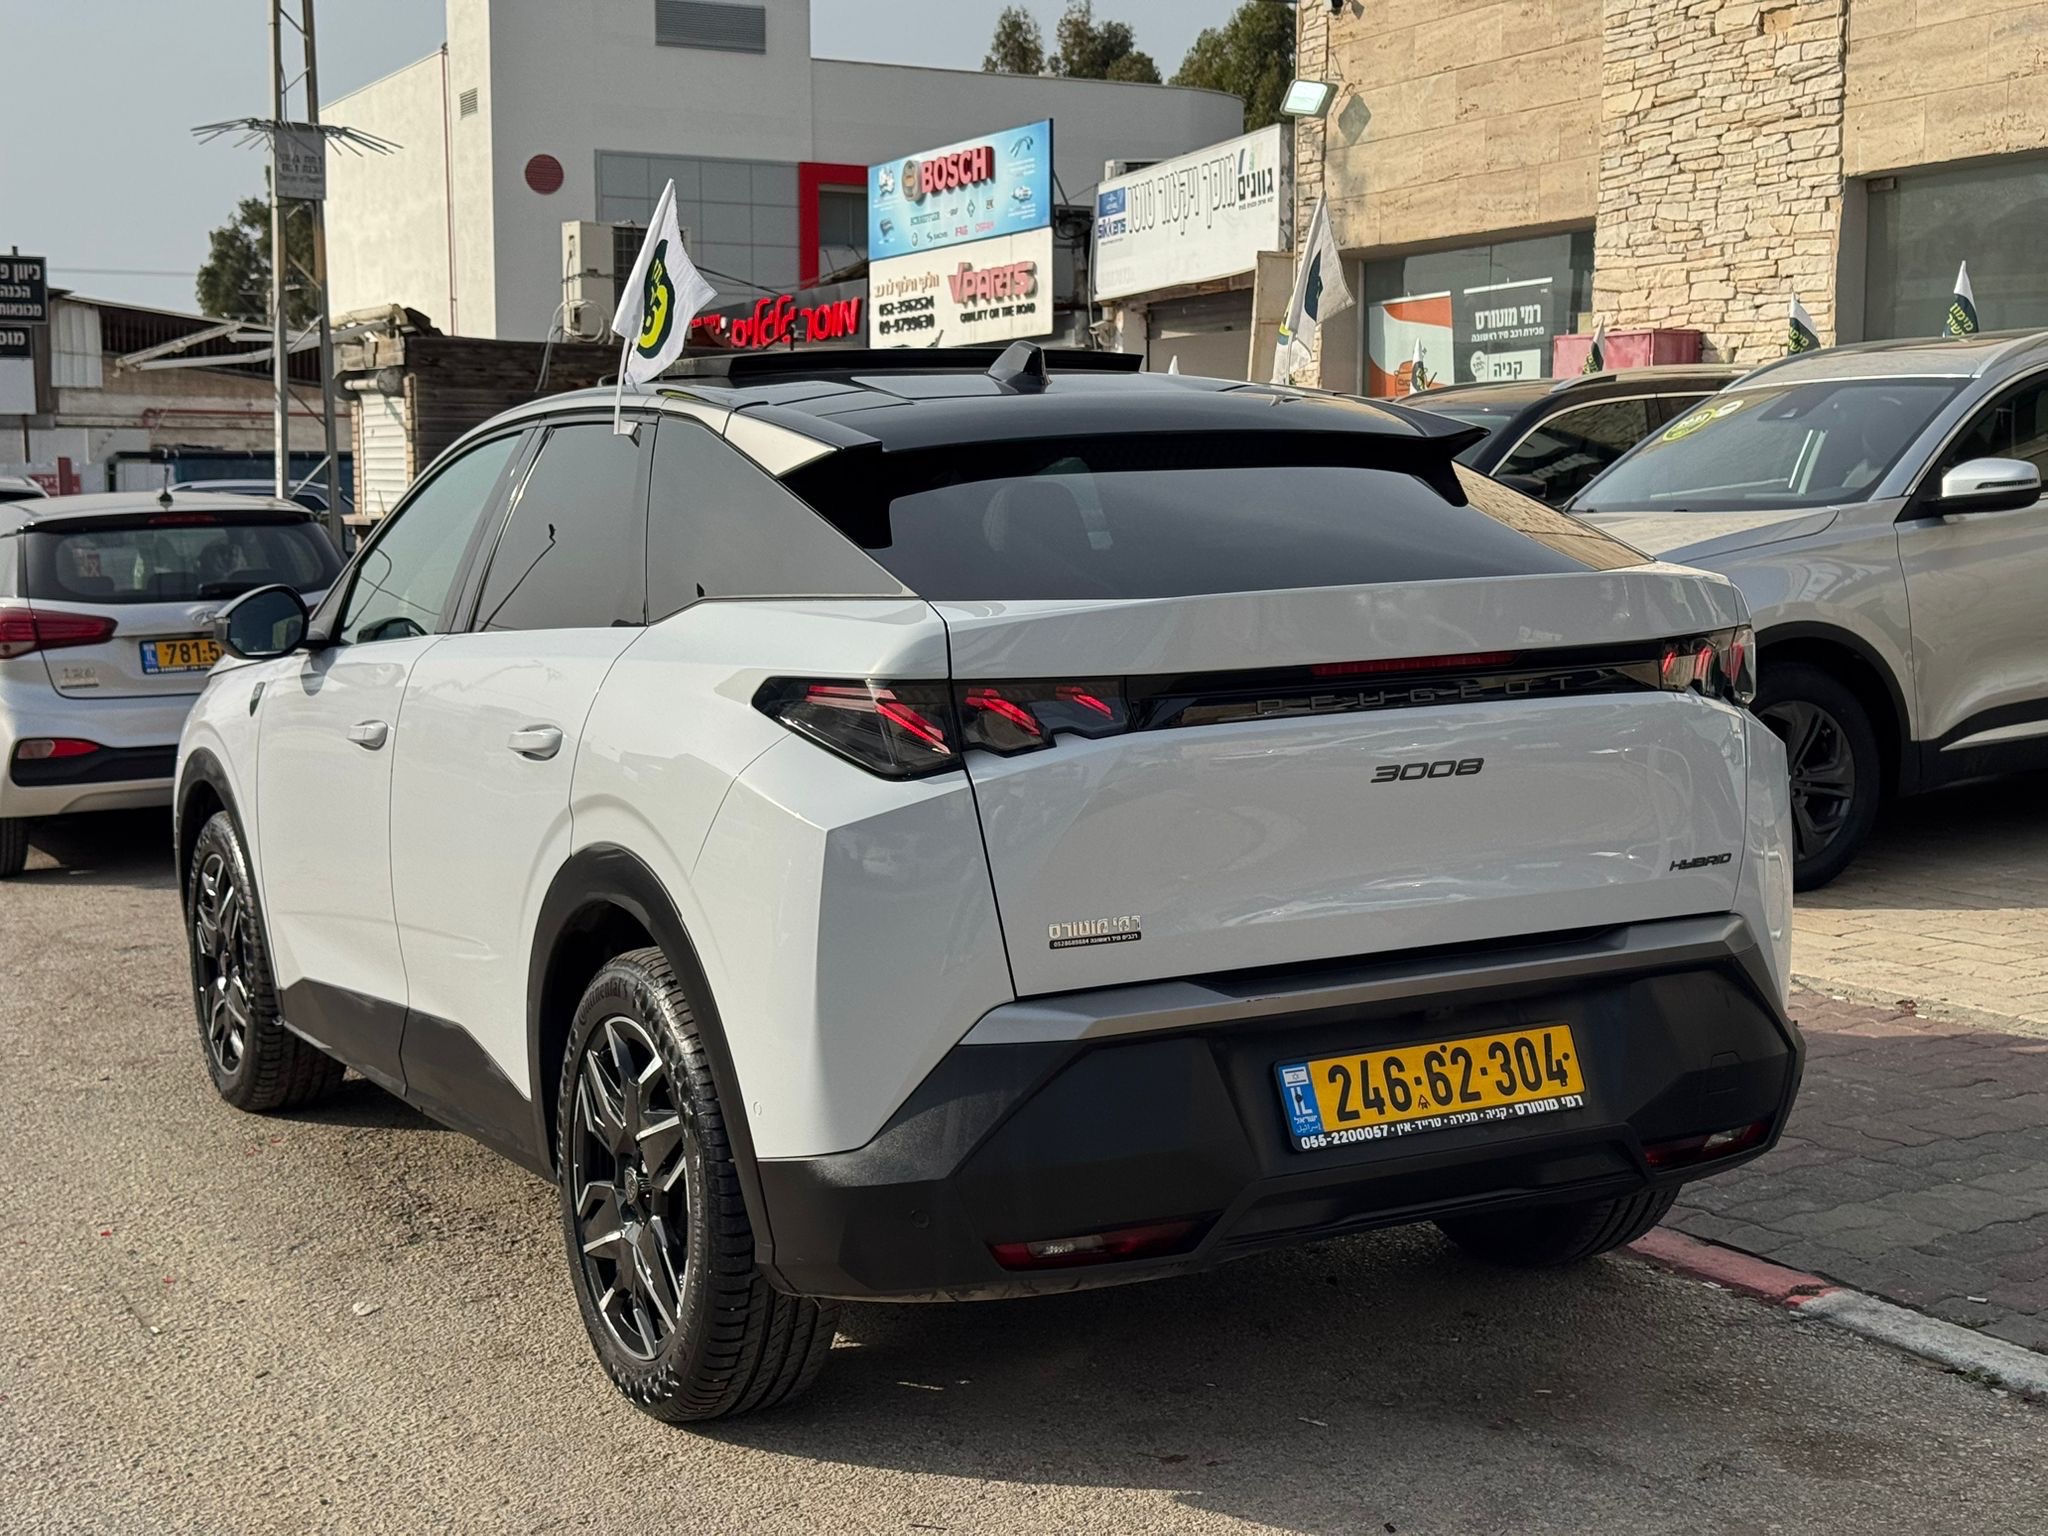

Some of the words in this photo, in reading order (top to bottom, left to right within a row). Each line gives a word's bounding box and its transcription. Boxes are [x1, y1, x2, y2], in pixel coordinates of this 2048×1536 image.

[921, 146, 991, 194] BOSCH
[1238, 167, 1274, 201] גוונים
[13, 264, 41, 283] כיוון
[1001, 305, 1015, 316] THE
[1016, 302, 1036, 315] ROAD
[1474, 306, 1518, 331] מוטורס
[1519, 303, 1541, 325] רמי
[1471, 332, 1497, 343] ראשונה
[1510, 328, 1523, 339] רכב
[1493, 360, 1523, 380] קניה
[1257, 676, 1572, 714] PEUGEOT
[1371, 757, 1484, 784] 3008
[1669, 852, 1732, 872] HYBRID
[1048, 918, 1109, 940] מוטורס
[1112, 914, 1141, 932] רמי
[1290, 1085, 1313, 1116] IL
[1515, 1099, 1559, 1115] מוטורס
[1561, 1094, 1584, 1107] רמי
[1294, 1114, 1318, 1125] ישראל
[1450, 1112, 1478, 1126] מכירה
[1485, 1108, 1507, 1120] קניה
[1301, 1124, 1389, 1150] 055-2200057
